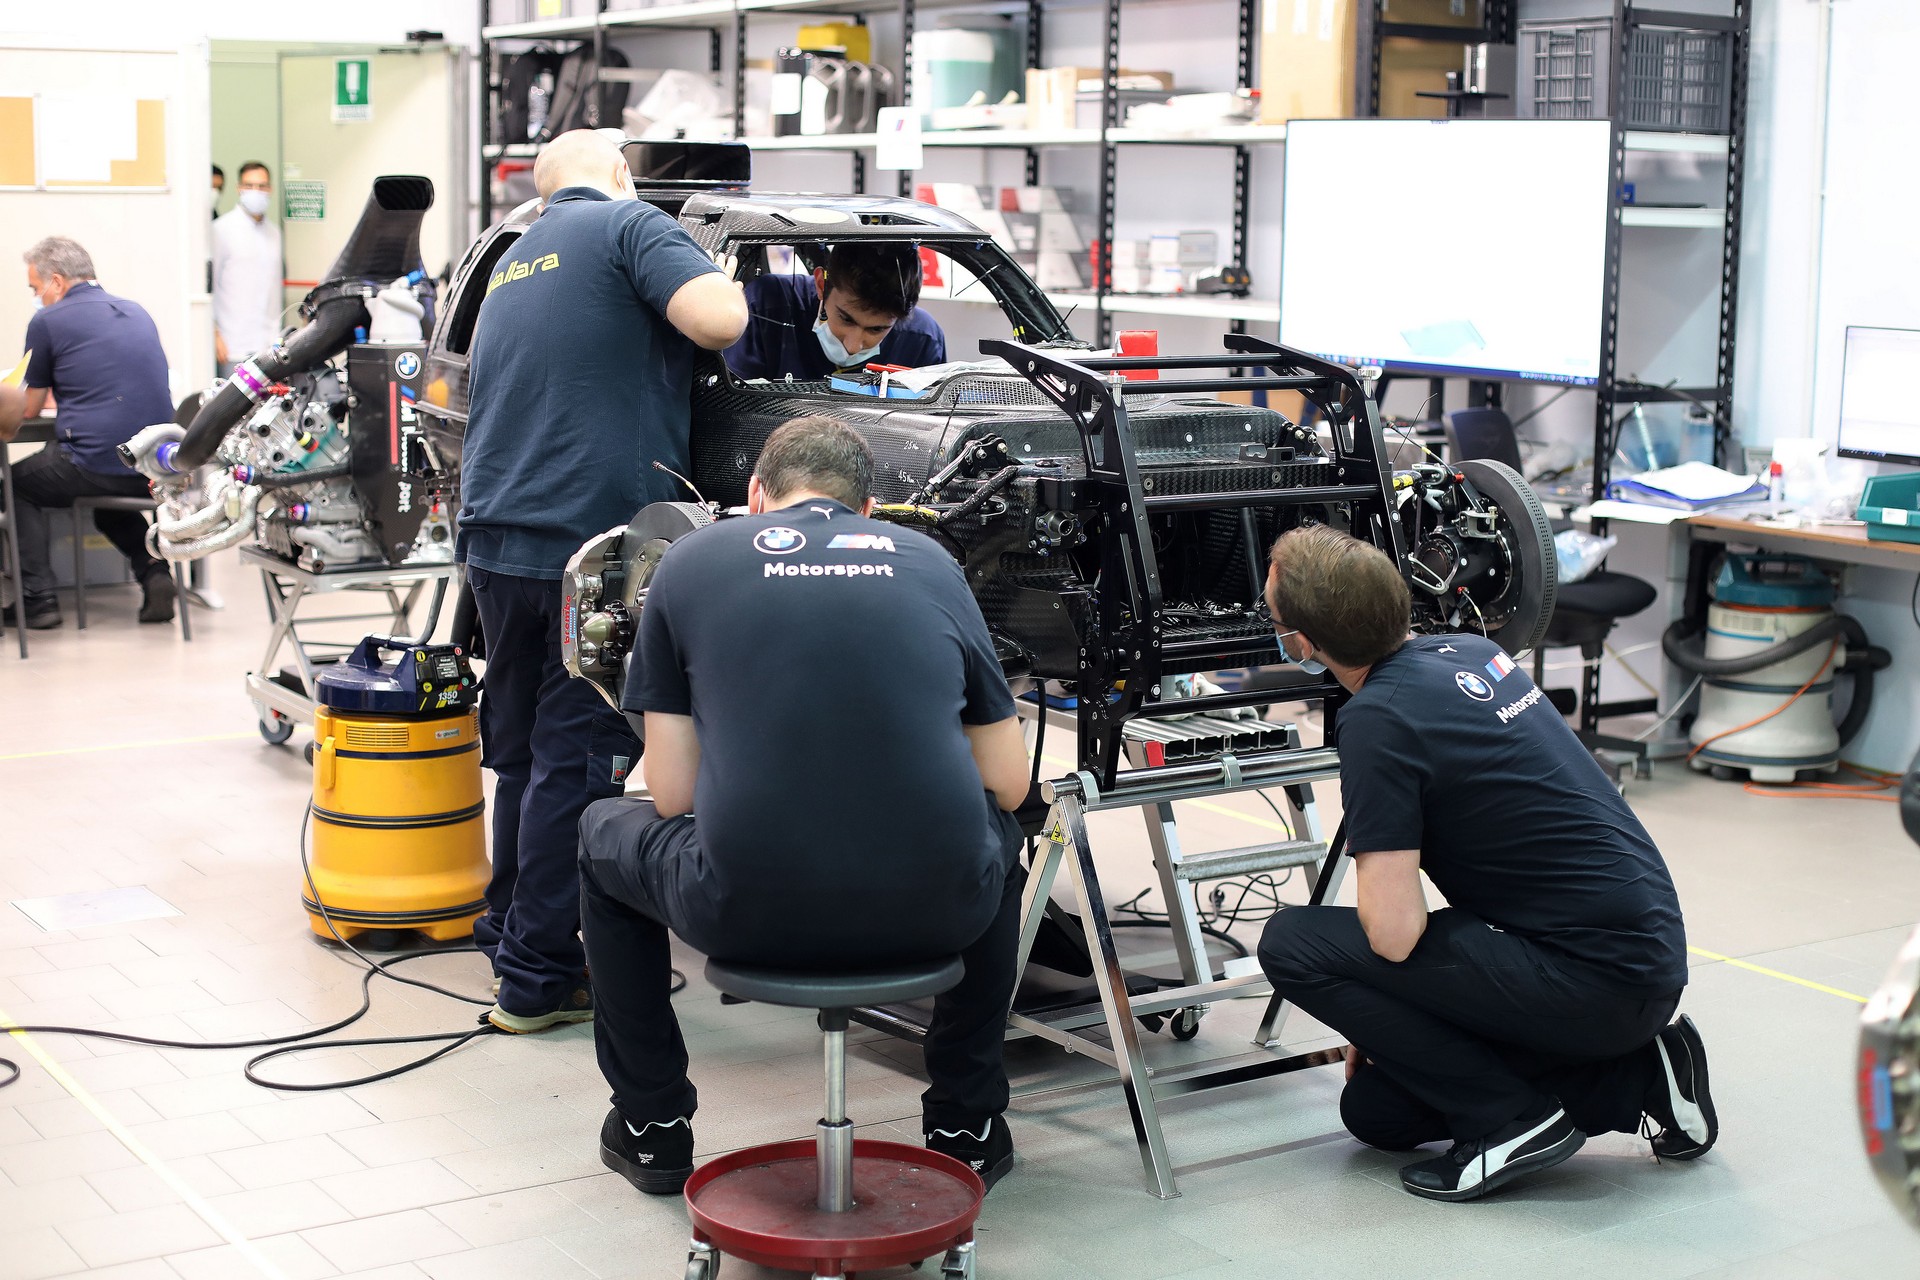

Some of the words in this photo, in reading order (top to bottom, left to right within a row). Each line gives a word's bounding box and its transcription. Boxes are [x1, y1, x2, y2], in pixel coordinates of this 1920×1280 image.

[764, 562, 894, 578] Motorsport
[563, 595, 571, 644] brembo
[438, 690, 458, 701] 1350
[1495, 684, 1544, 724] Motorsport
